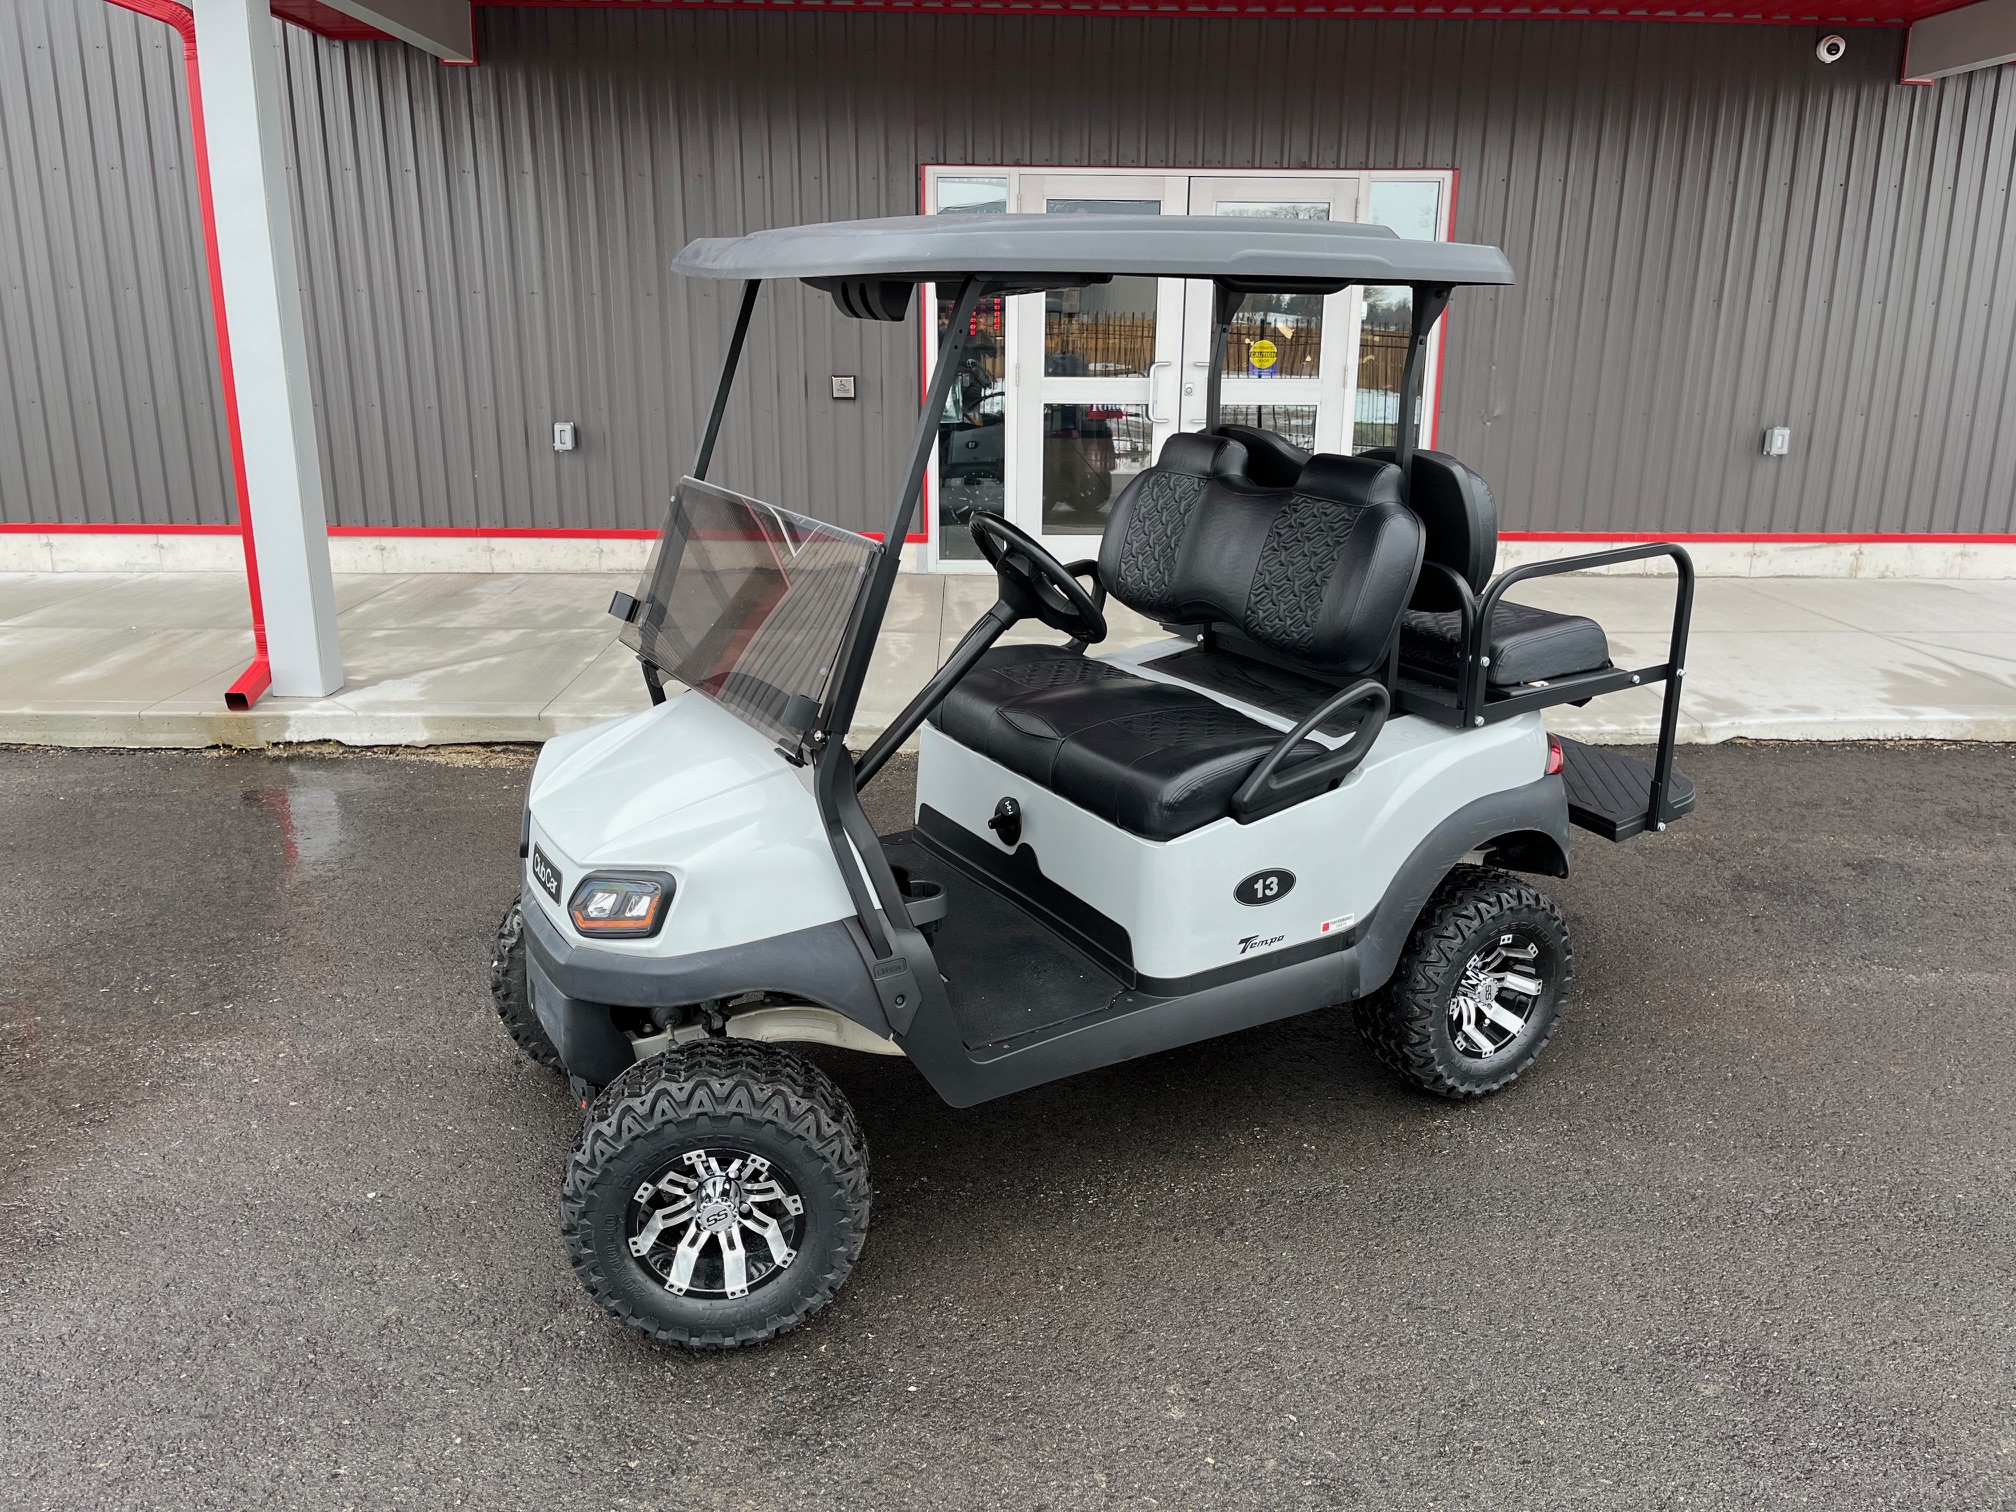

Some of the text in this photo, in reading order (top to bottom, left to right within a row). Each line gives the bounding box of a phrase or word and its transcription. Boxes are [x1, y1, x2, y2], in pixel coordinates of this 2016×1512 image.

[534, 853, 558, 894] Club Car
[1253, 876, 1279, 899] 13
[1237, 934, 1286, 955] Tempo
[706, 1208, 729, 1227] SS
